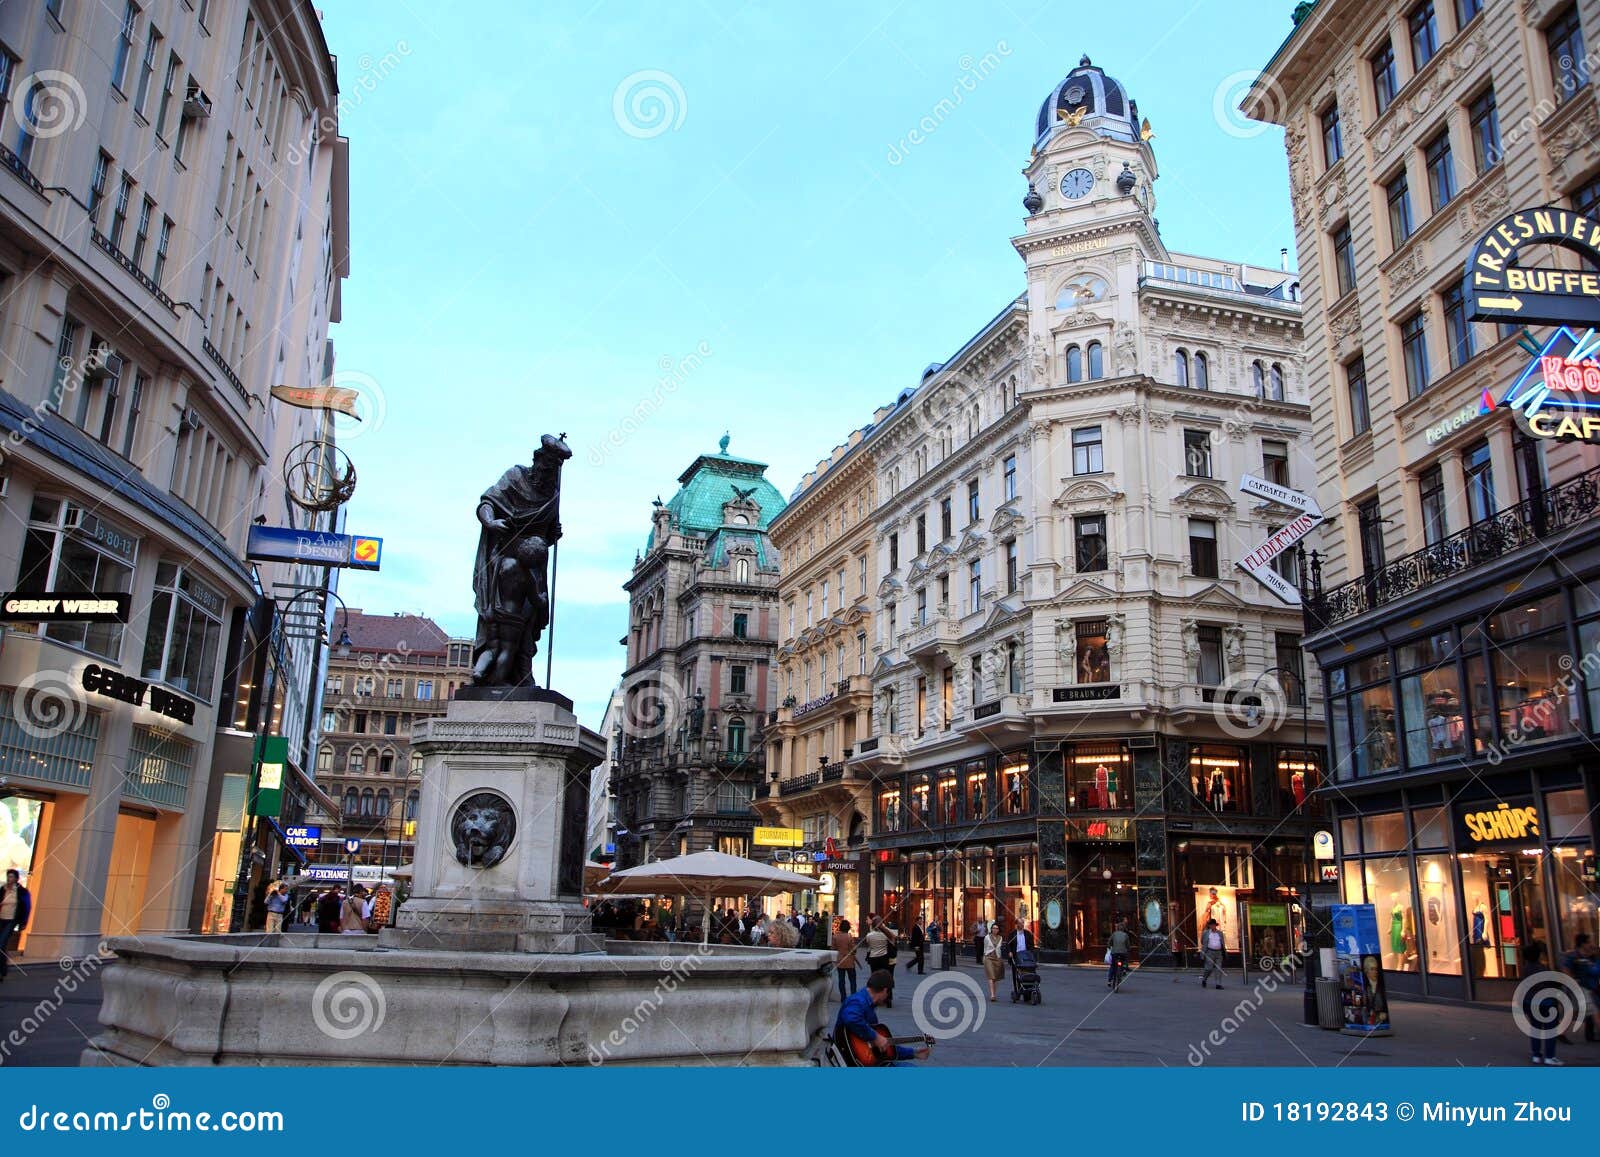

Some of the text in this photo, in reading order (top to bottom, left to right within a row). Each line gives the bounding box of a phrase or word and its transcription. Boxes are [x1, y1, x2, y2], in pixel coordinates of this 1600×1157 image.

[1052, 238, 1107, 257] GENERALI
[1506, 269, 1600, 295] BUFFE
[1425, 403, 1480, 445] helvetia
[1244, 515, 1314, 571] FLEDERMAUS
[1265, 574, 1289, 594] MUSIC
[5, 600, 119, 614] GERRY WEBER
[82, 663, 196, 726] GERRY WEBER
[1069, 689, 1095, 699] BRAUN
[1464, 802, 1541, 841] SCHÖPS
[285, 838, 319, 847] EUROPE
[347, 840, 359, 852] U
[316, 869, 349, 880] EXCHANGE
[828, 862, 856, 870] APOTHEKE
